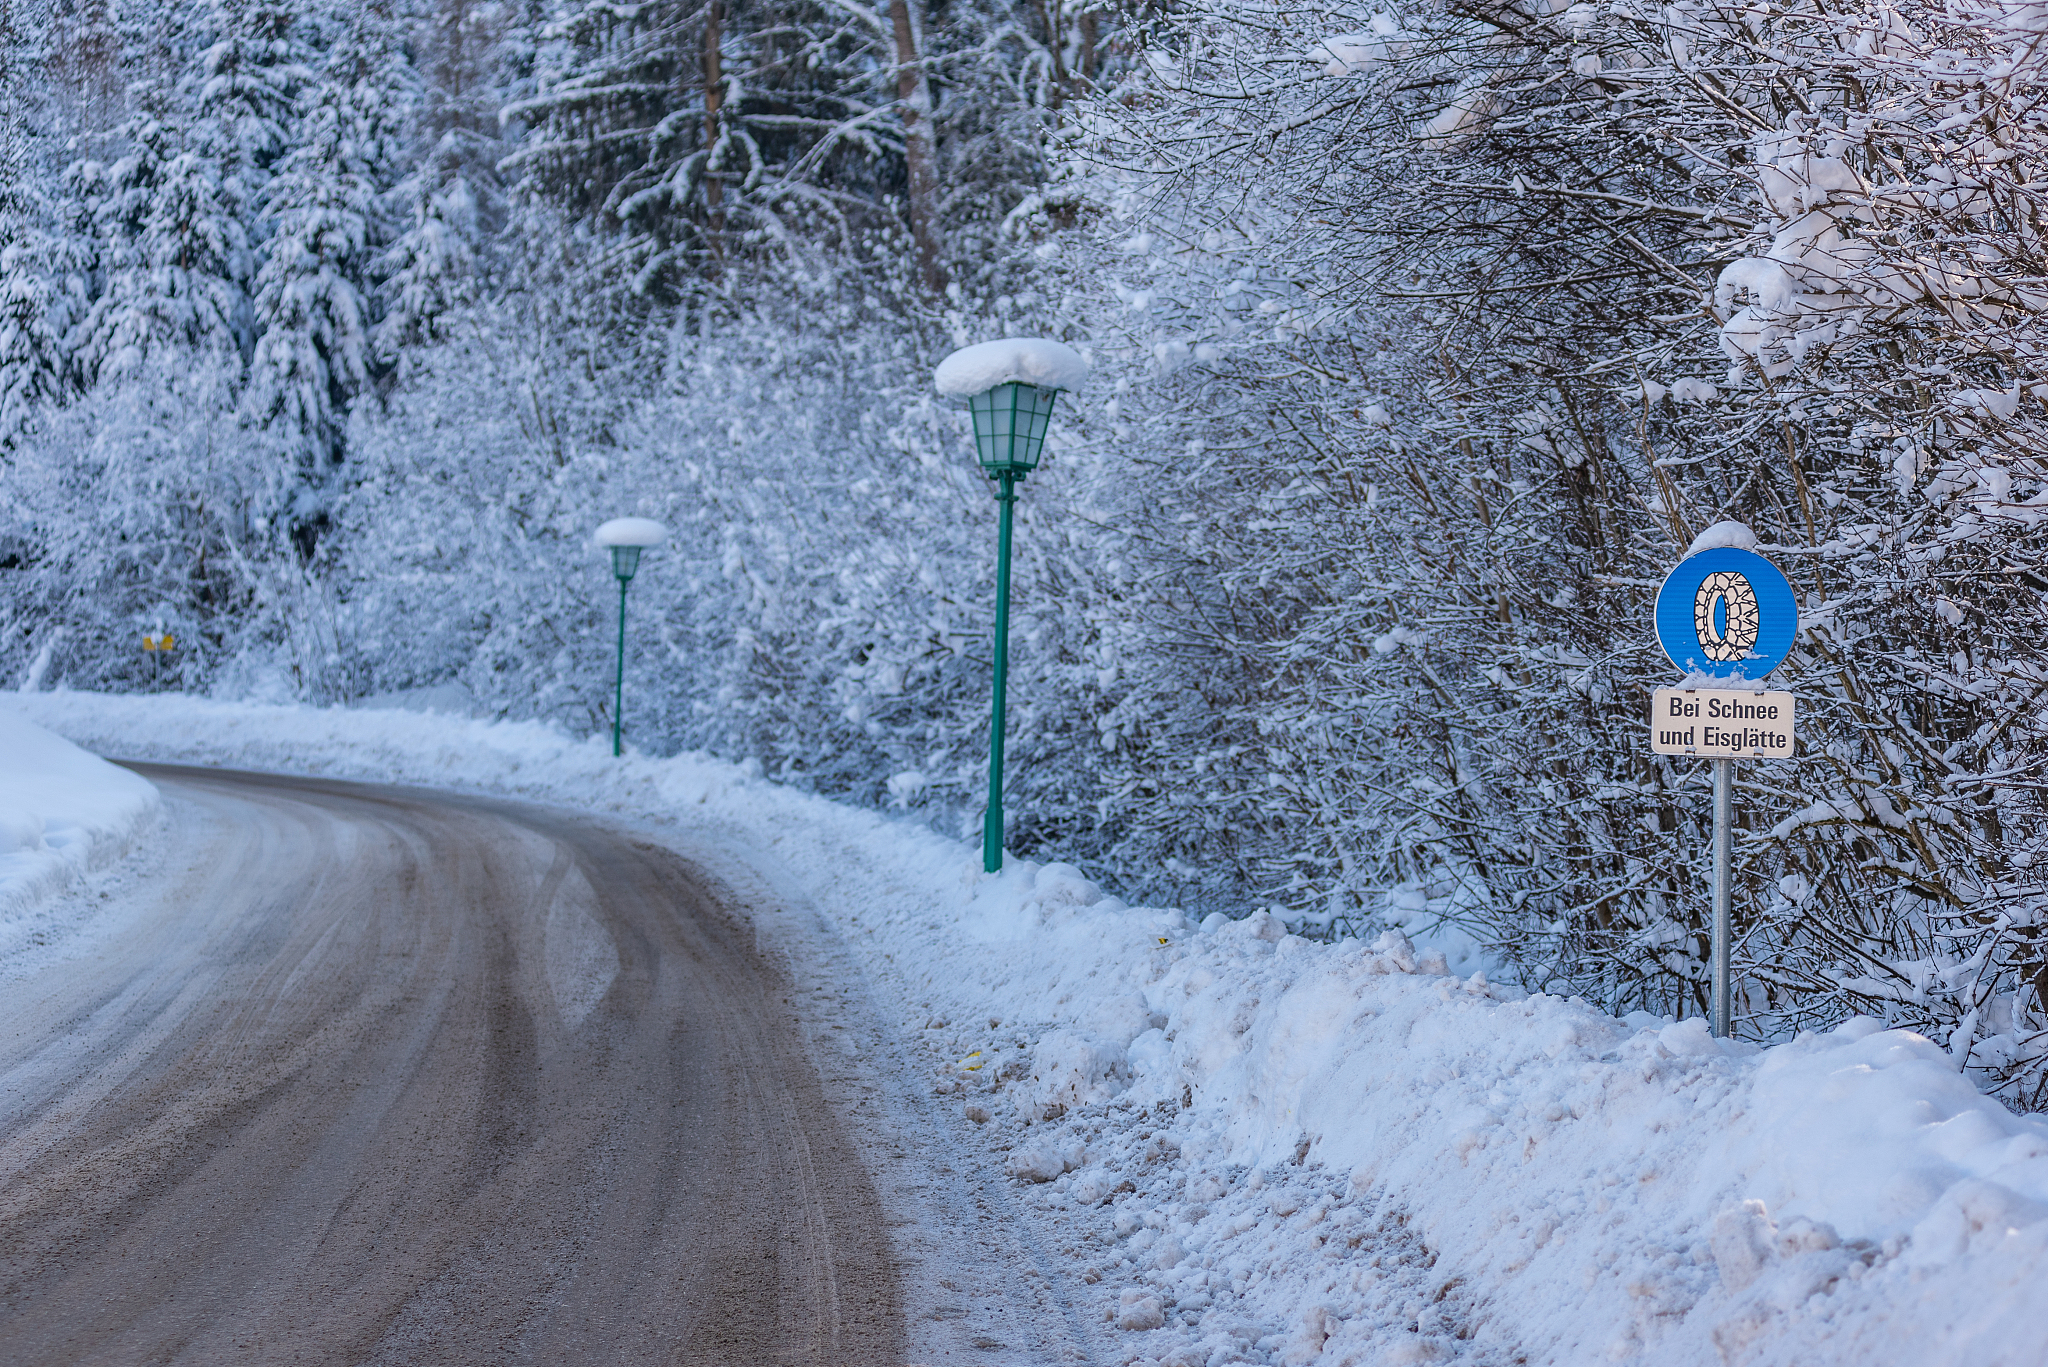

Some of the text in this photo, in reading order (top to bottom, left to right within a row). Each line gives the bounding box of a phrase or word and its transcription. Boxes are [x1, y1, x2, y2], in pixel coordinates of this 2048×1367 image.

[1669, 697, 1779, 720] Bei Schnee
[1659, 726, 1787, 752] und Eisglätte
